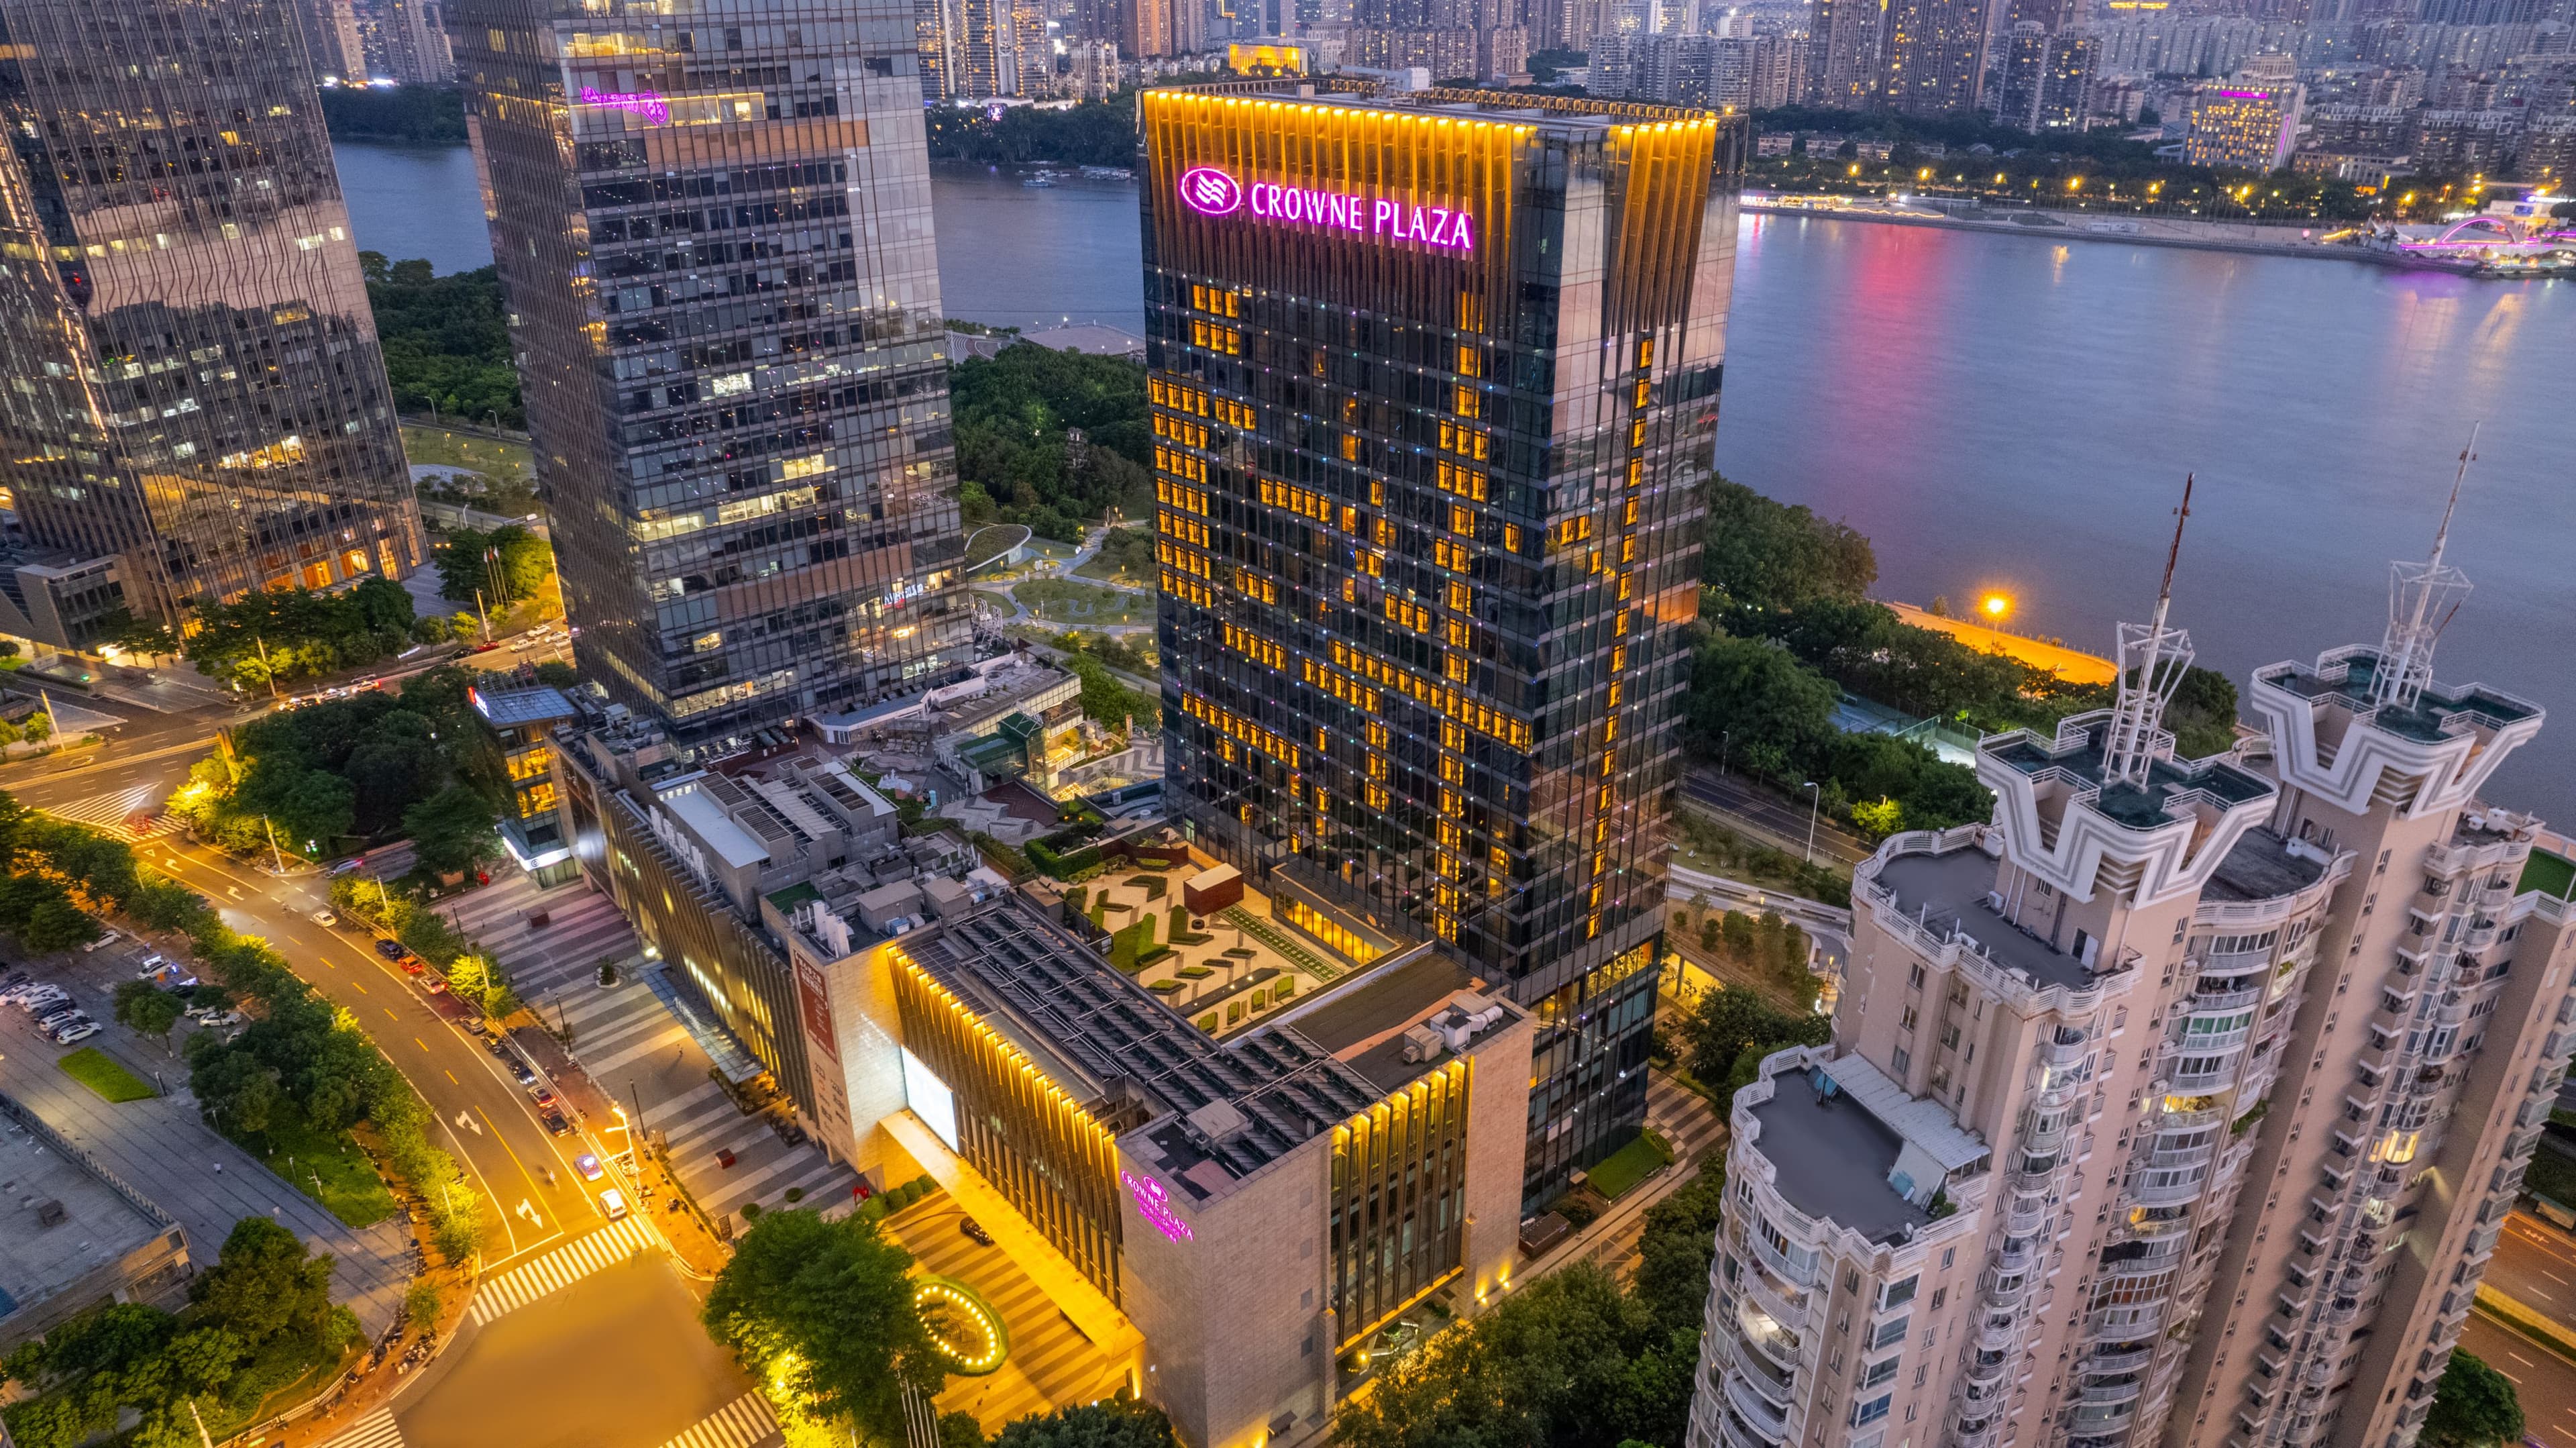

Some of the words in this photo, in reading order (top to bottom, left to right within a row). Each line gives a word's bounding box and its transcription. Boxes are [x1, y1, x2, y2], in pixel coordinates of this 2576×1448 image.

[1251, 182, 1363, 231] CROWNE
[1375, 199, 1471, 249] PLAZA
[1121, 1170, 1160, 1210] CROWNE
[1163, 1206, 1194, 1241] PLAZA
